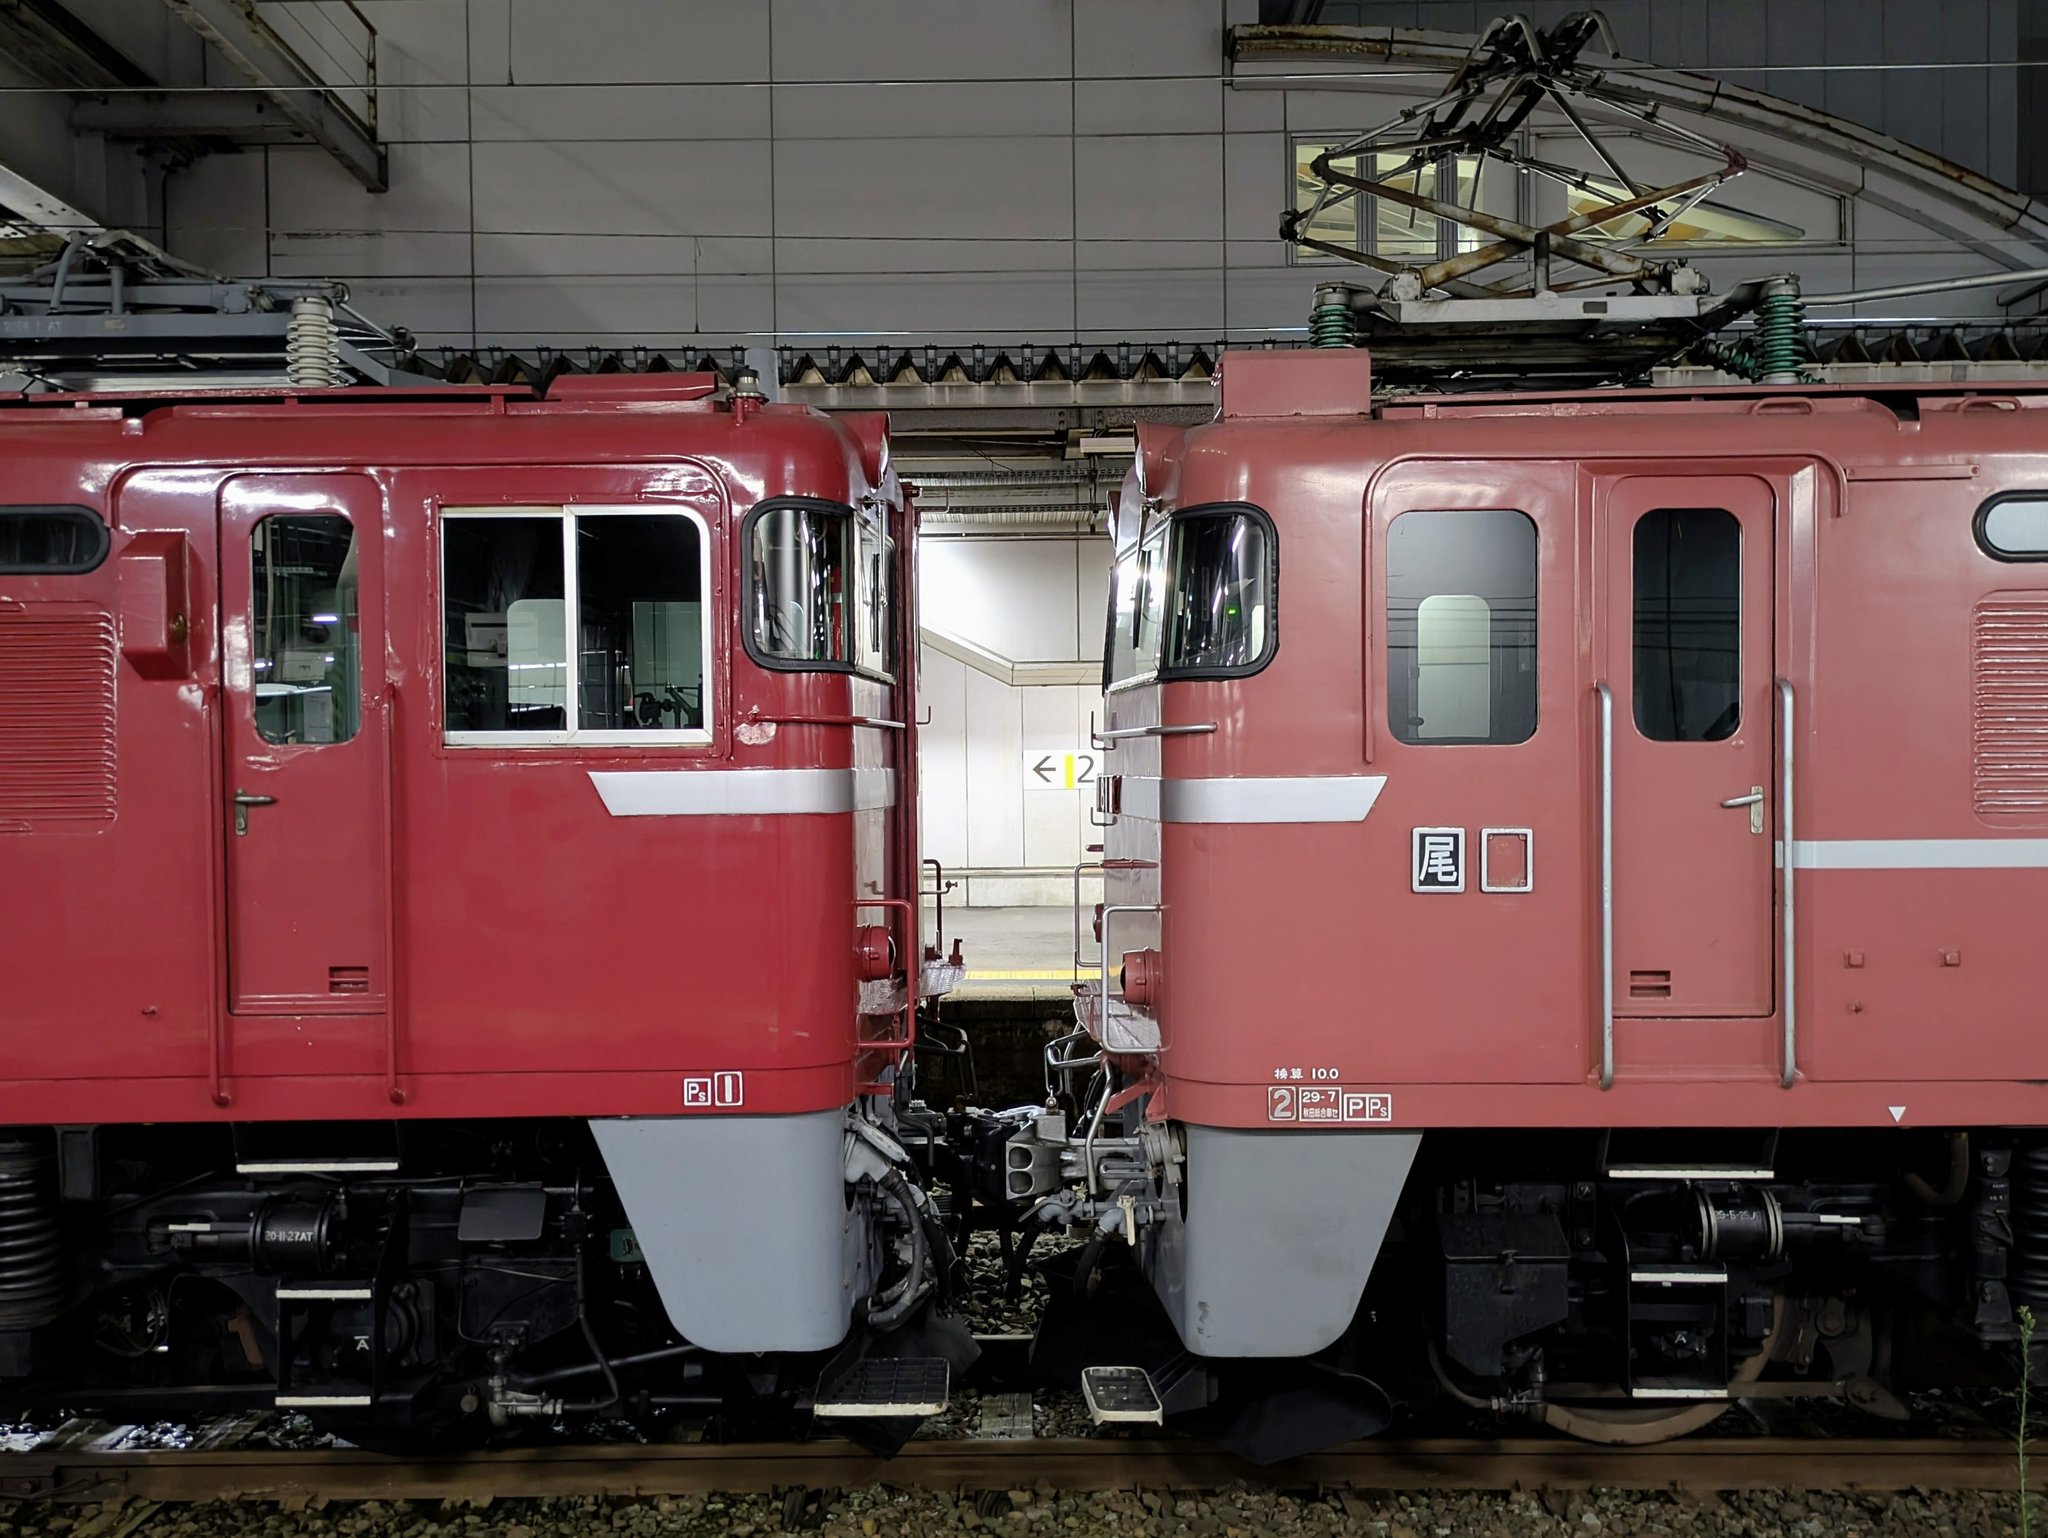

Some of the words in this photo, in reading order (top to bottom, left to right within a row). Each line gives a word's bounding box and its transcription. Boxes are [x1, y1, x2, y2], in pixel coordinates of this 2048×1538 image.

[1077, 755, 1095, 783] 2
[1419, 836, 1458, 882] 尾
[1274, 1067, 1303, 1080] 換算
[1311, 1067, 1339, 1080] 10.0
[688, 1082, 706, 1102] Ps
[1273, 1089, 1292, 1118] 2
[1349, 1098, 1364, 1116] P
[1370, 1098, 1388, 1117] Ps
